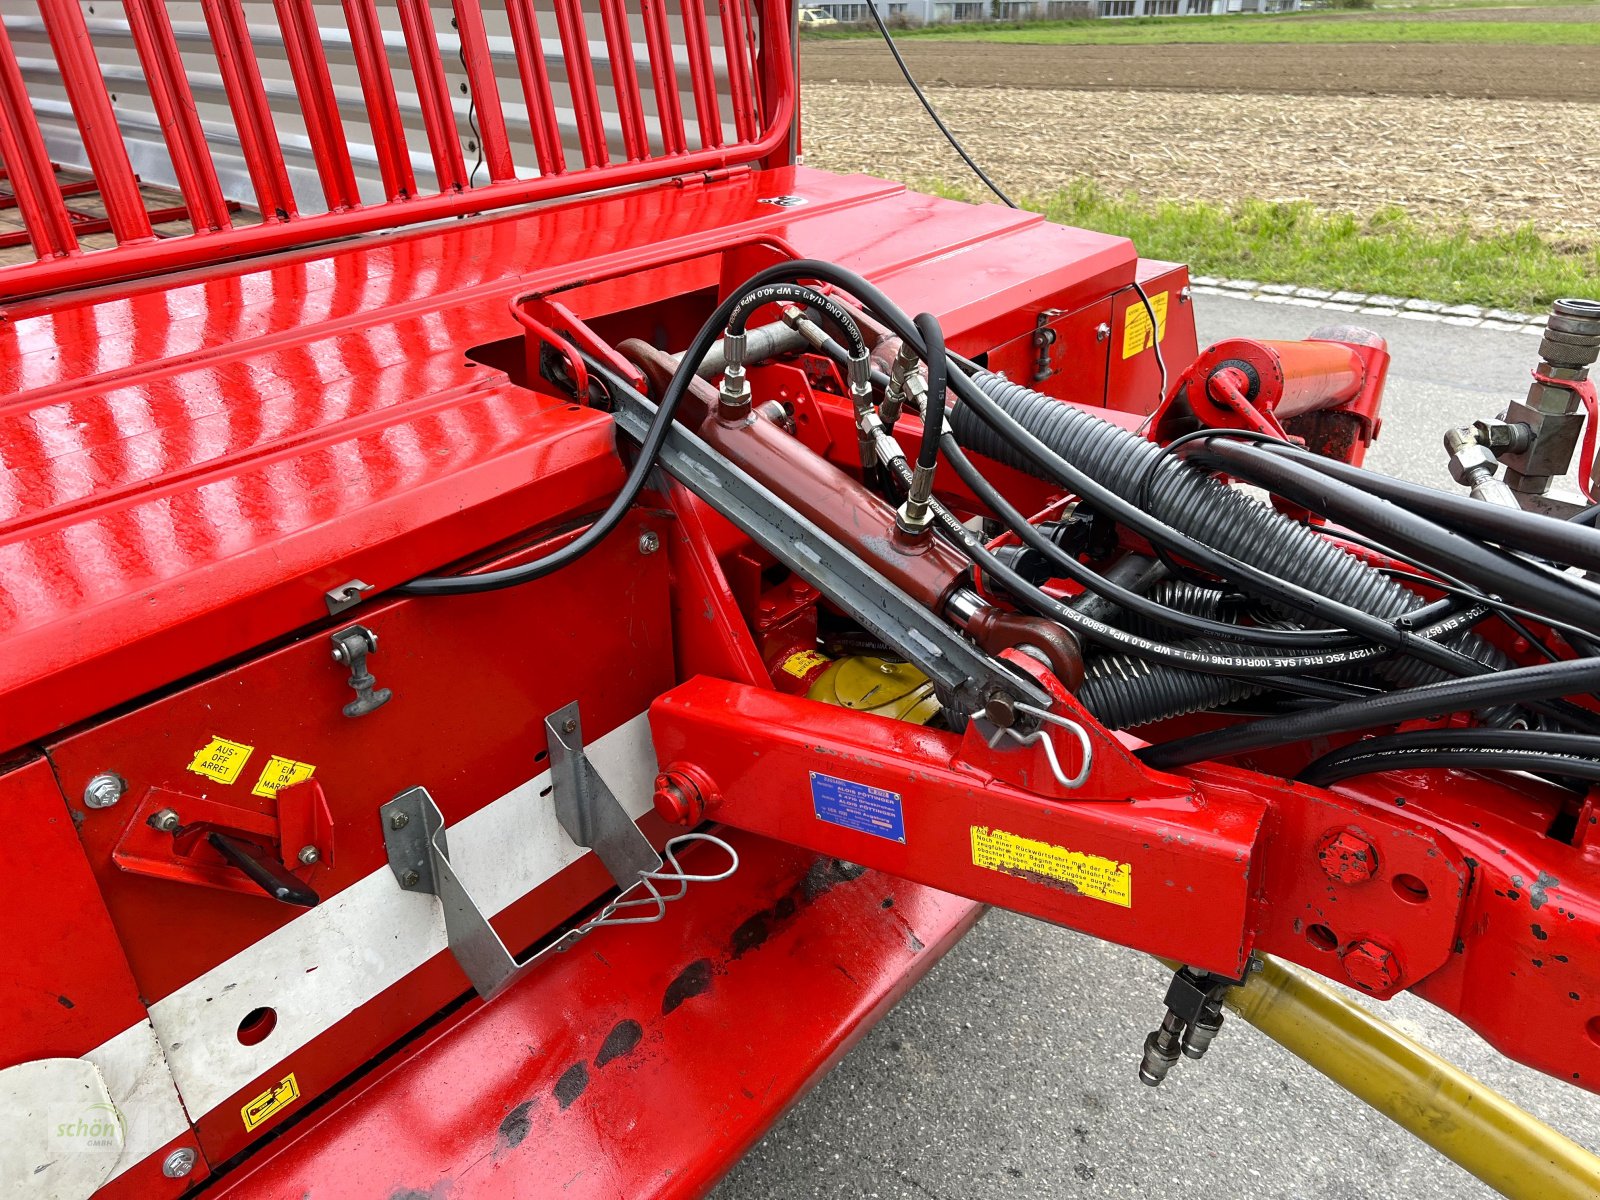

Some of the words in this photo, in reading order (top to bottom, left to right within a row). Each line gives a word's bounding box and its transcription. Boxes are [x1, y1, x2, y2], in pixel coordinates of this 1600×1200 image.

[757, 288, 775, 298] 40.0
[777, 287, 792, 295] WP
[740, 294, 756, 307] MPa
[825, 303, 842, 318] DN6
[841, 316, 860, 342] 100R16
[942, 513, 960, 532] GATES
[1062, 608, 1082, 622] PSI)
[1082, 618, 1107, 634] (5800
[1442, 619, 1459, 632] EN
[1109, 629, 1131, 643] MPa
[1425, 626, 1443, 639] 857
[1131, 637, 1152, 650] 40.0
[1153, 645, 1171, 656] WP
[1348, 647, 1377, 660] 11237
[1211, 655, 1233, 666] DN6
[1235, 658, 1272, 667] 100R16
[1275, 658, 1296, 667] SAE
[1303, 657, 1324, 666] R16
[1325, 653, 1346, 664] 2SC
[211, 753, 229, 764] OFF
[200, 760, 230, 775] ARRET
[281, 765, 297, 776] EIN
[278, 774, 291, 783] ON
[837, 786, 857, 795] ALOIS
[857, 791, 895, 805] PÖTTINGER
[838, 798, 858, 808] ALOIS
[859, 804, 896, 818] PÖTTINGER
[976, 834, 993, 844] Nach
[995, 840, 1012, 849] einer
[1089, 865, 1102, 873] der
[977, 847, 1005, 859] obachtet
[1029, 855, 1054, 866] Beginn
[1055, 863, 1073, 871] einer
[977, 854, 997, 864] zogen
[1108, 889, 1126, 898] ohne
